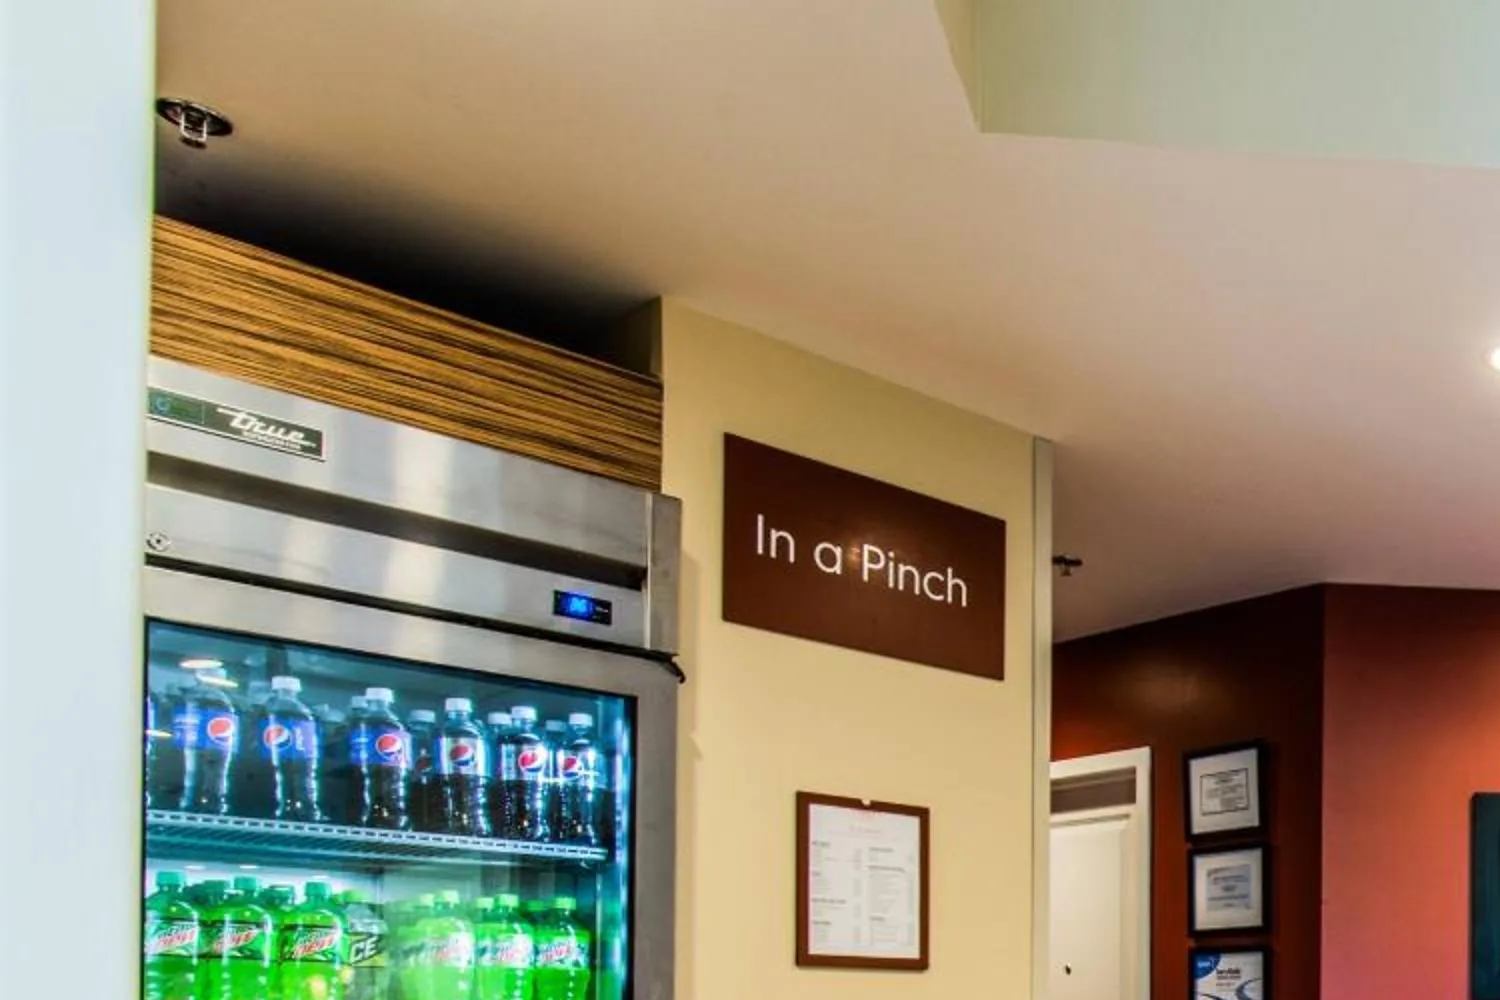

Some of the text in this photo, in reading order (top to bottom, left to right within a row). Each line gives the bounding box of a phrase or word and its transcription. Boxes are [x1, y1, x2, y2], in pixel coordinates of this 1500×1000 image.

[756, 513, 968, 608] In a Pinch
